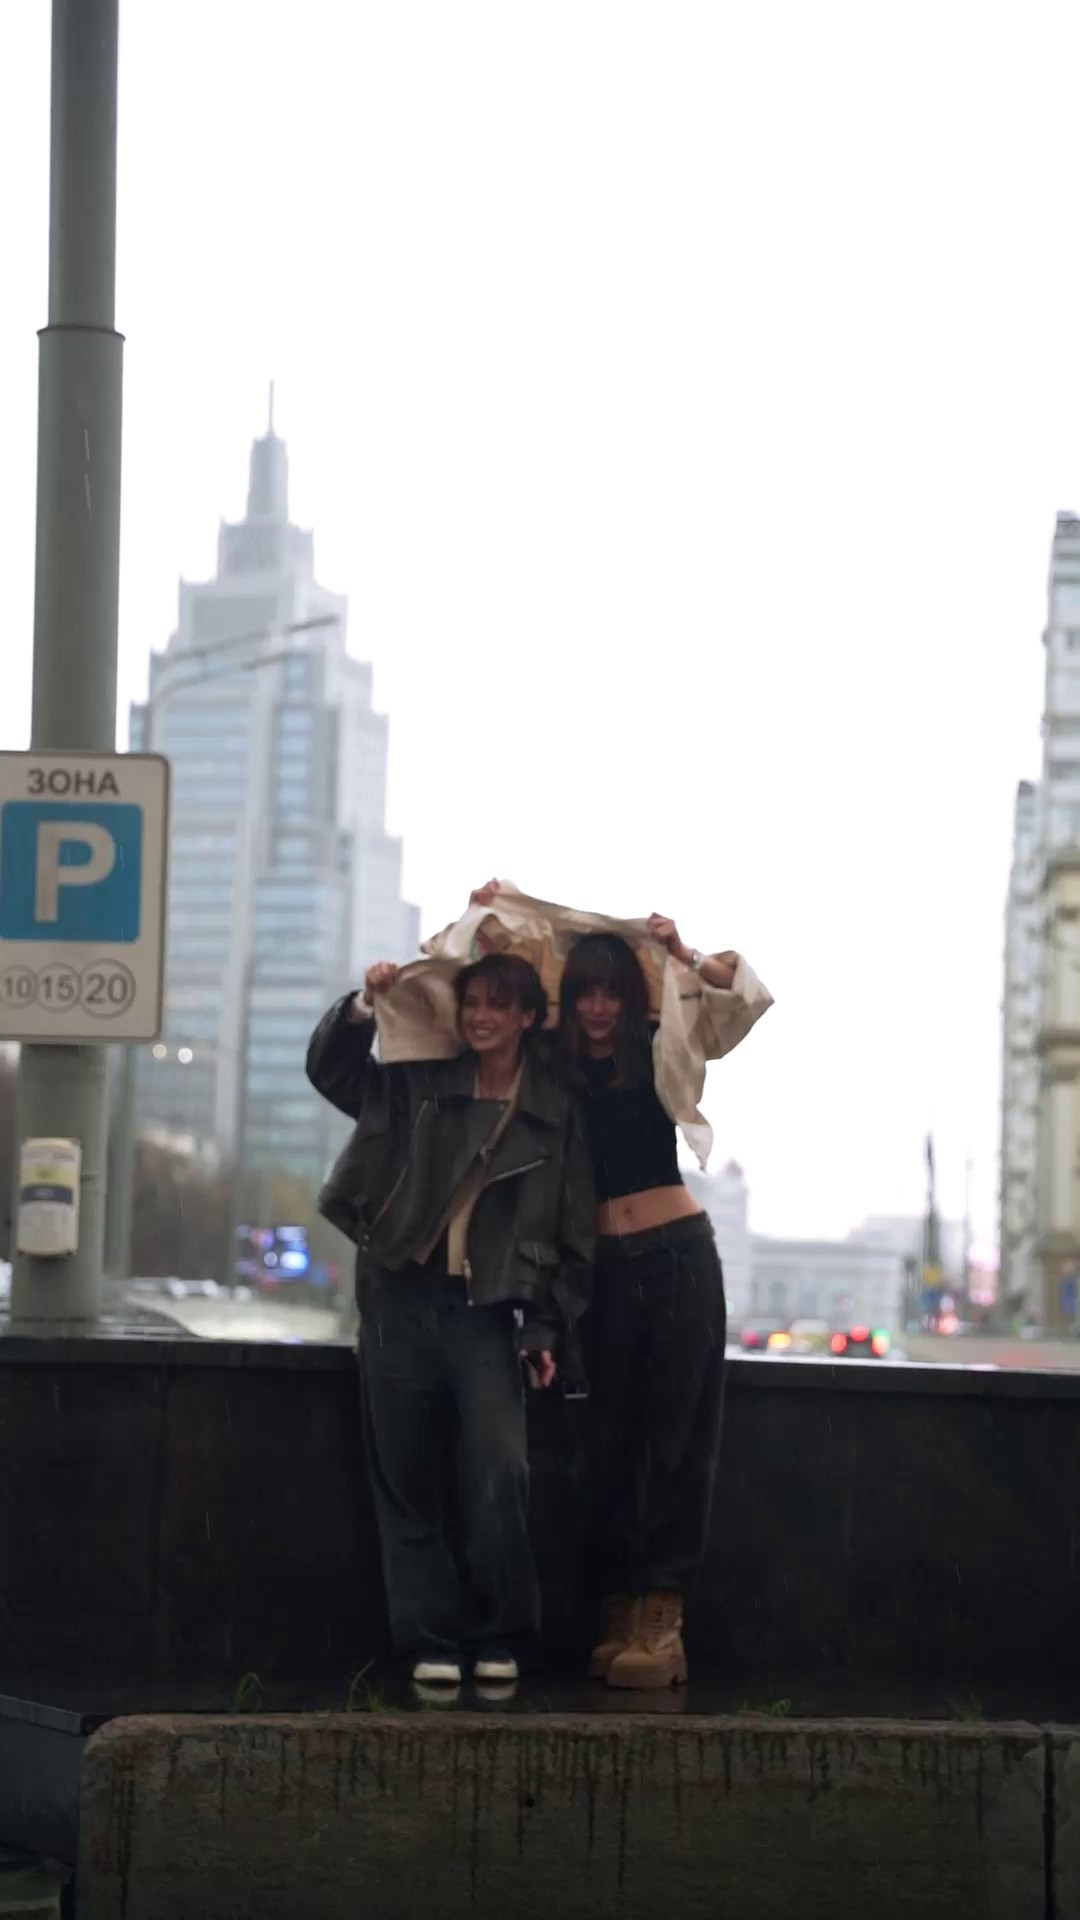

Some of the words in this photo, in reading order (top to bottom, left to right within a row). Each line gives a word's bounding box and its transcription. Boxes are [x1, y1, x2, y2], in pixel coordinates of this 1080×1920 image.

[27, 768, 120, 796] ЗОНА
[34, 821, 116, 923] P
[4, 977, 33, 1000] 10
[41, 977, 75, 1001] 15
[85, 973, 128, 1005] 20
